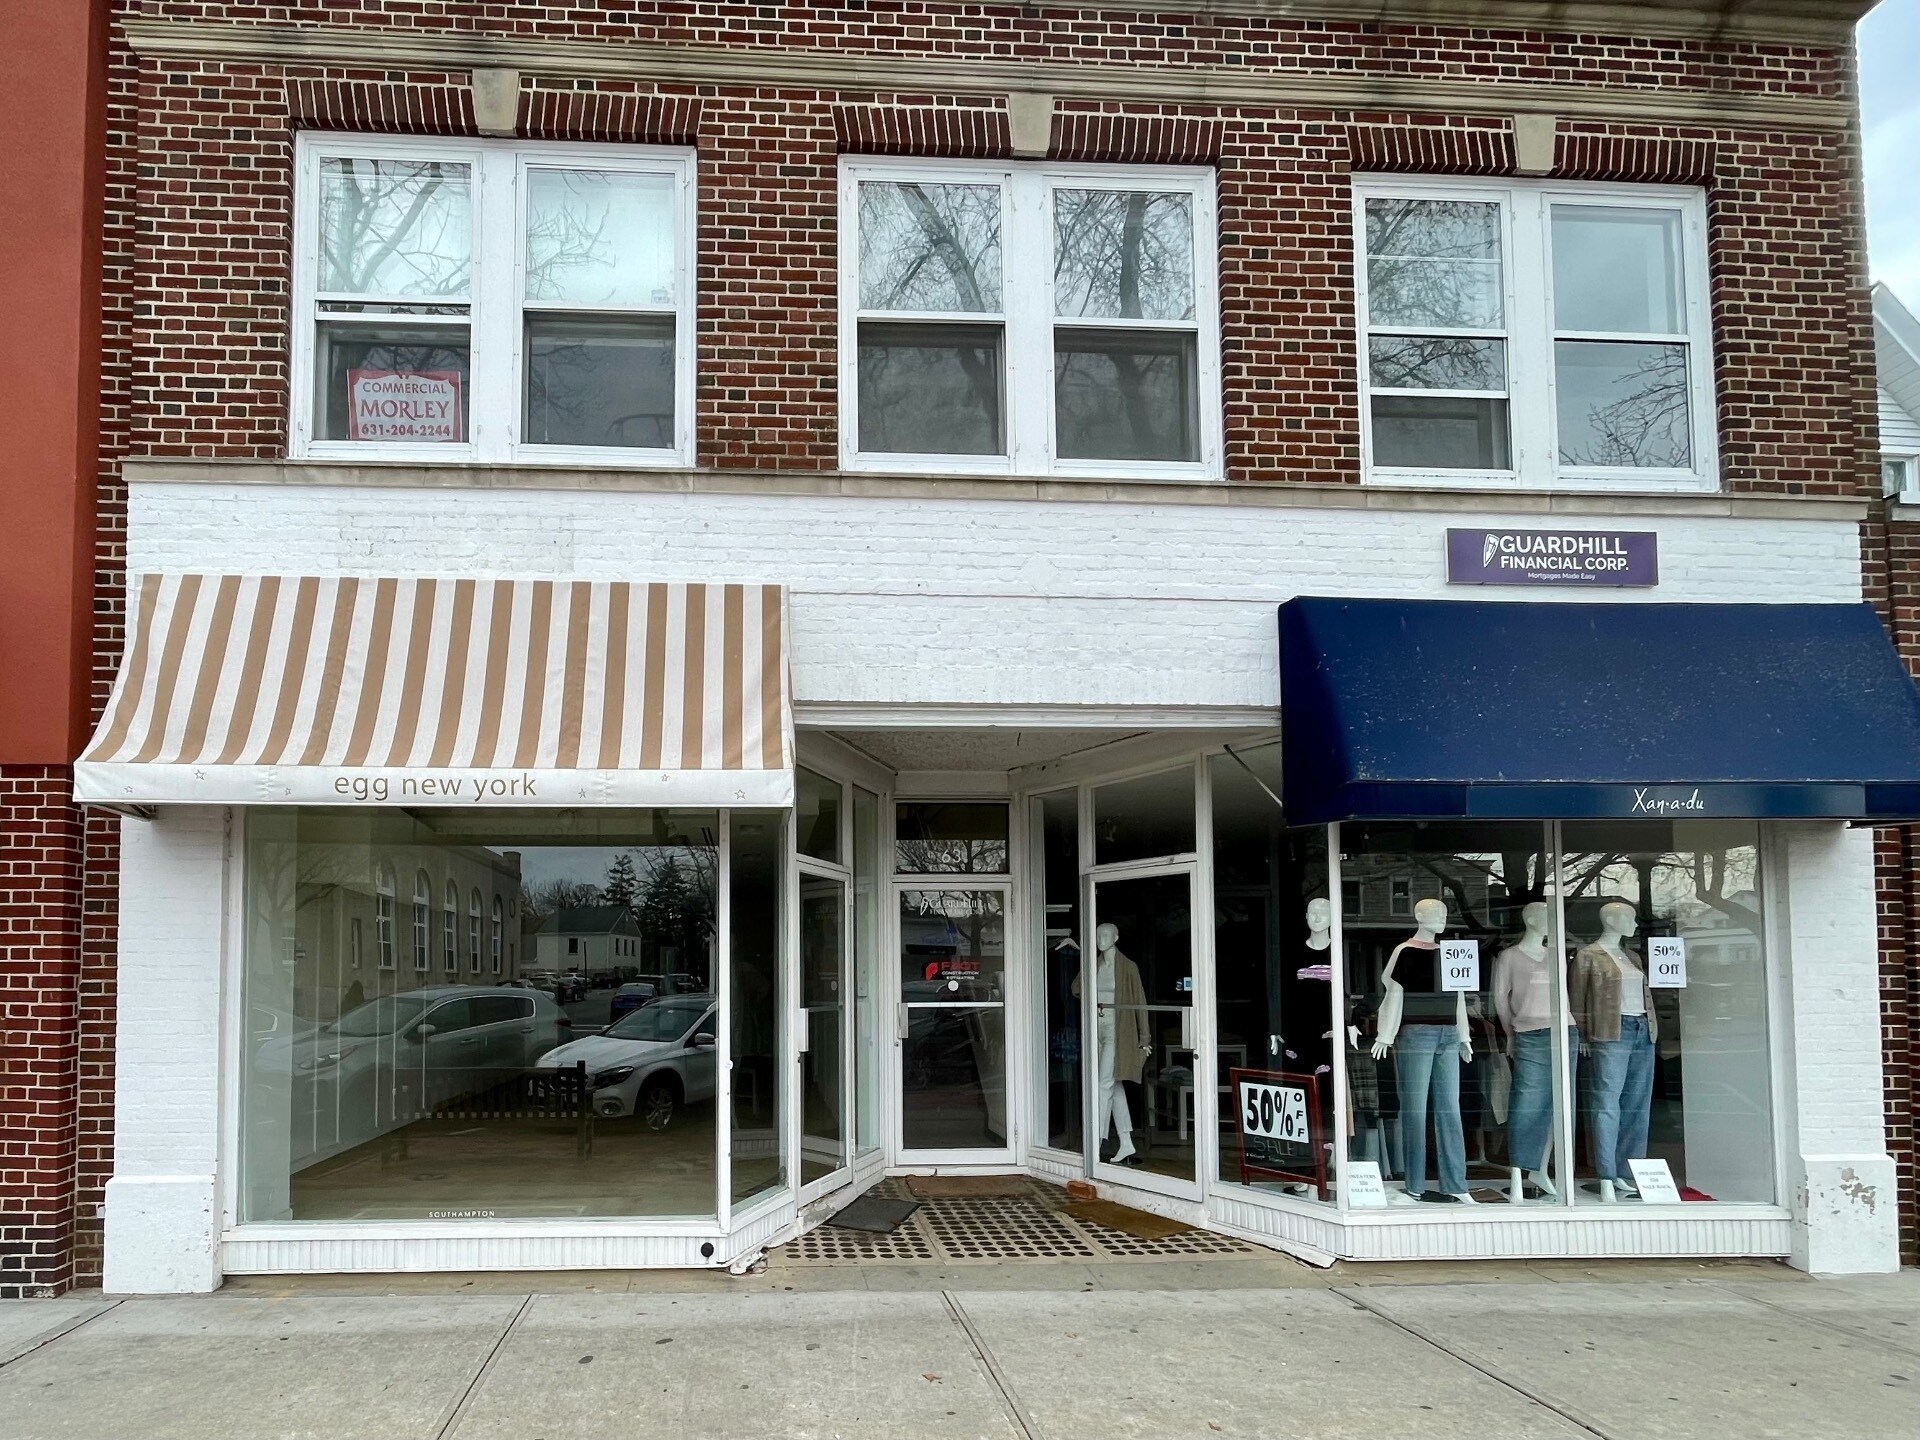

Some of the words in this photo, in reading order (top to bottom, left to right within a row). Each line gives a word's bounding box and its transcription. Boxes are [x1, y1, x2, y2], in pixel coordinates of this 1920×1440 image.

[362, 382, 447, 394] COMMERCIAL
[360, 399, 450, 421] MORLEY
[361, 424, 450, 436] 631-204-2244
[1500, 535, 1628, 555] GUARDHILL
[1500, 556, 1582, 570] FINANCIAL
[1584, 557, 1629, 571] CORP.
[1527, 572, 1561, 580] Mortgages
[1580, 572, 1596, 581] Easy
[334, 776, 389, 801] egg
[402, 778, 462, 796] new
[473, 772, 537, 802] york
[941, 848, 961, 863] 63
[1445, 948, 1473, 960] 50%
[1654, 945, 1681, 957] 50%
[1450, 967, 1471, 978] Off
[1658, 963, 1680, 975] Off
[1246, 1087, 1294, 1137] 50%
[1253, 1136, 1297, 1156] SALE
[428, 1210, 495, 1218] SOUTHAMPTON
